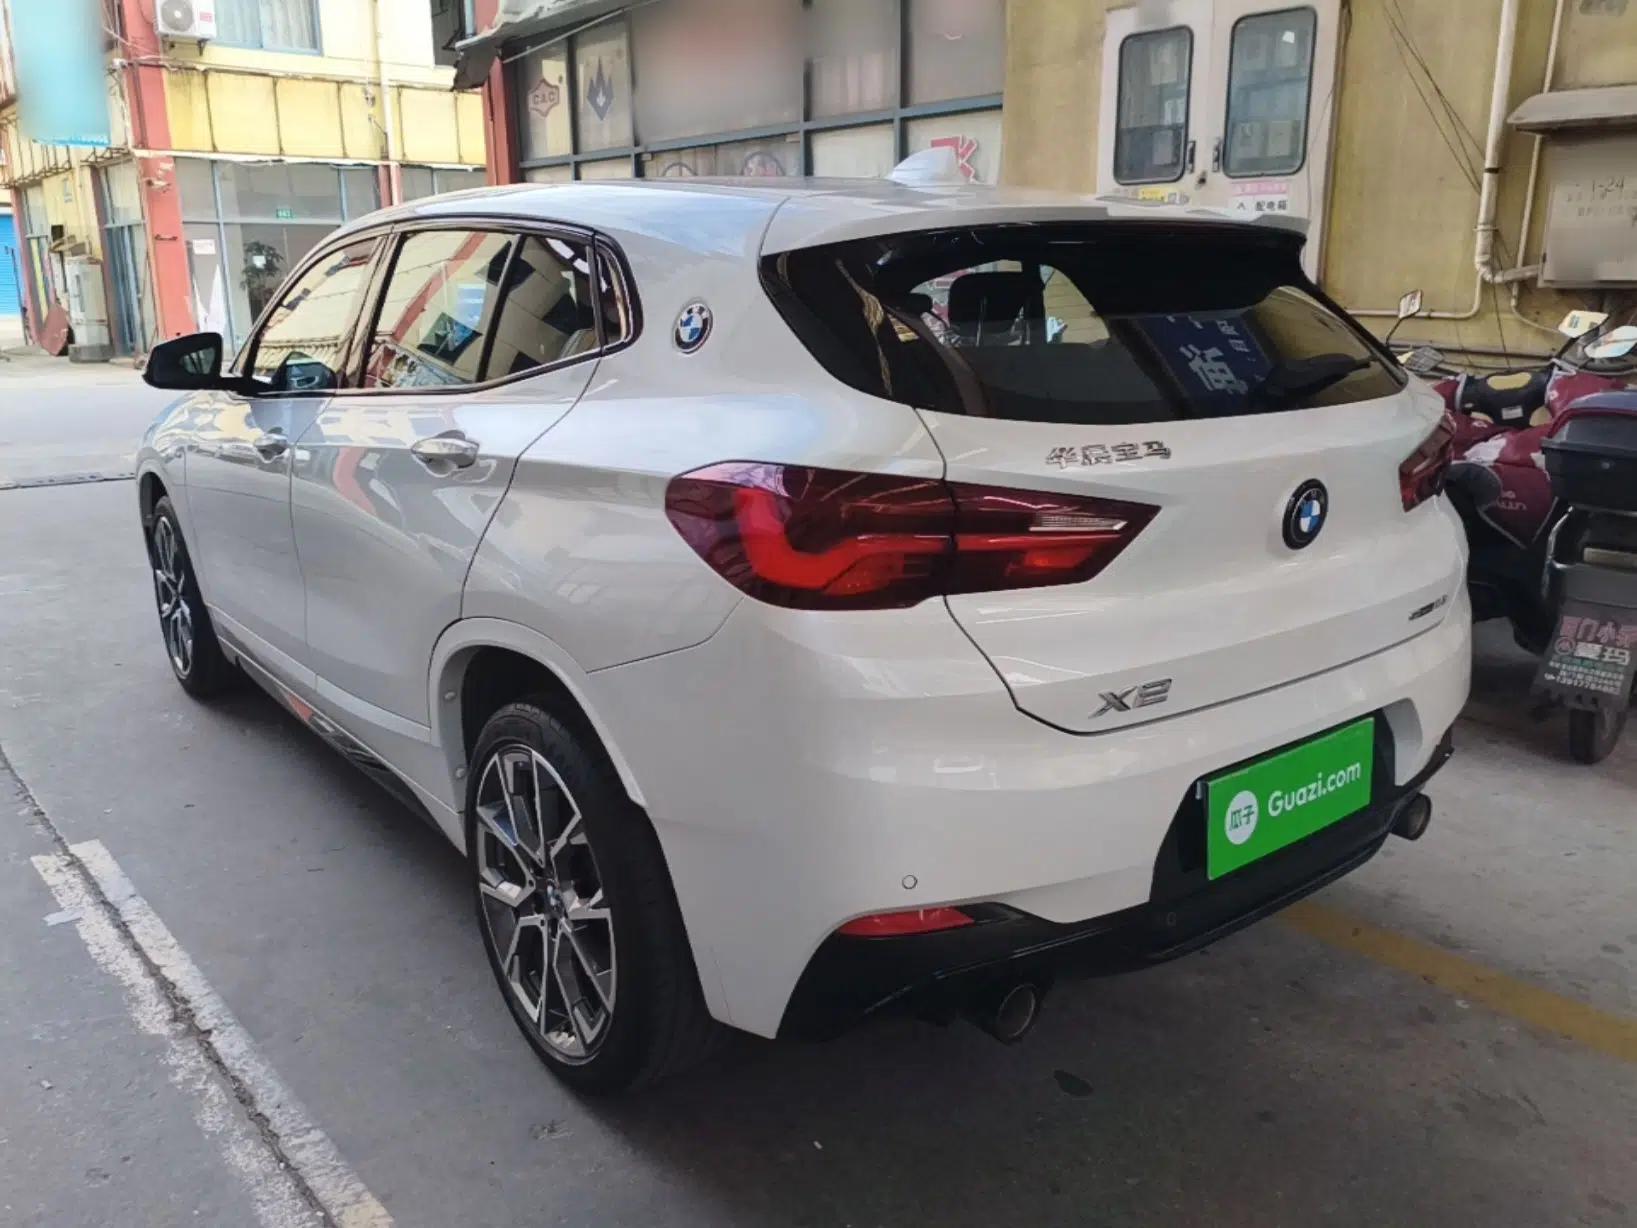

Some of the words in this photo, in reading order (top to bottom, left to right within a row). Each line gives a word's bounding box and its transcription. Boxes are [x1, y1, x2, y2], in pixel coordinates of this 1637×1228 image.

[1045, 441, 1171, 469] 华晨宝马
[1087, 678, 1173, 719] X2
[1229, 804, 1255, 831] 瓜子
[1268, 762, 1361, 817] Guazi.com
